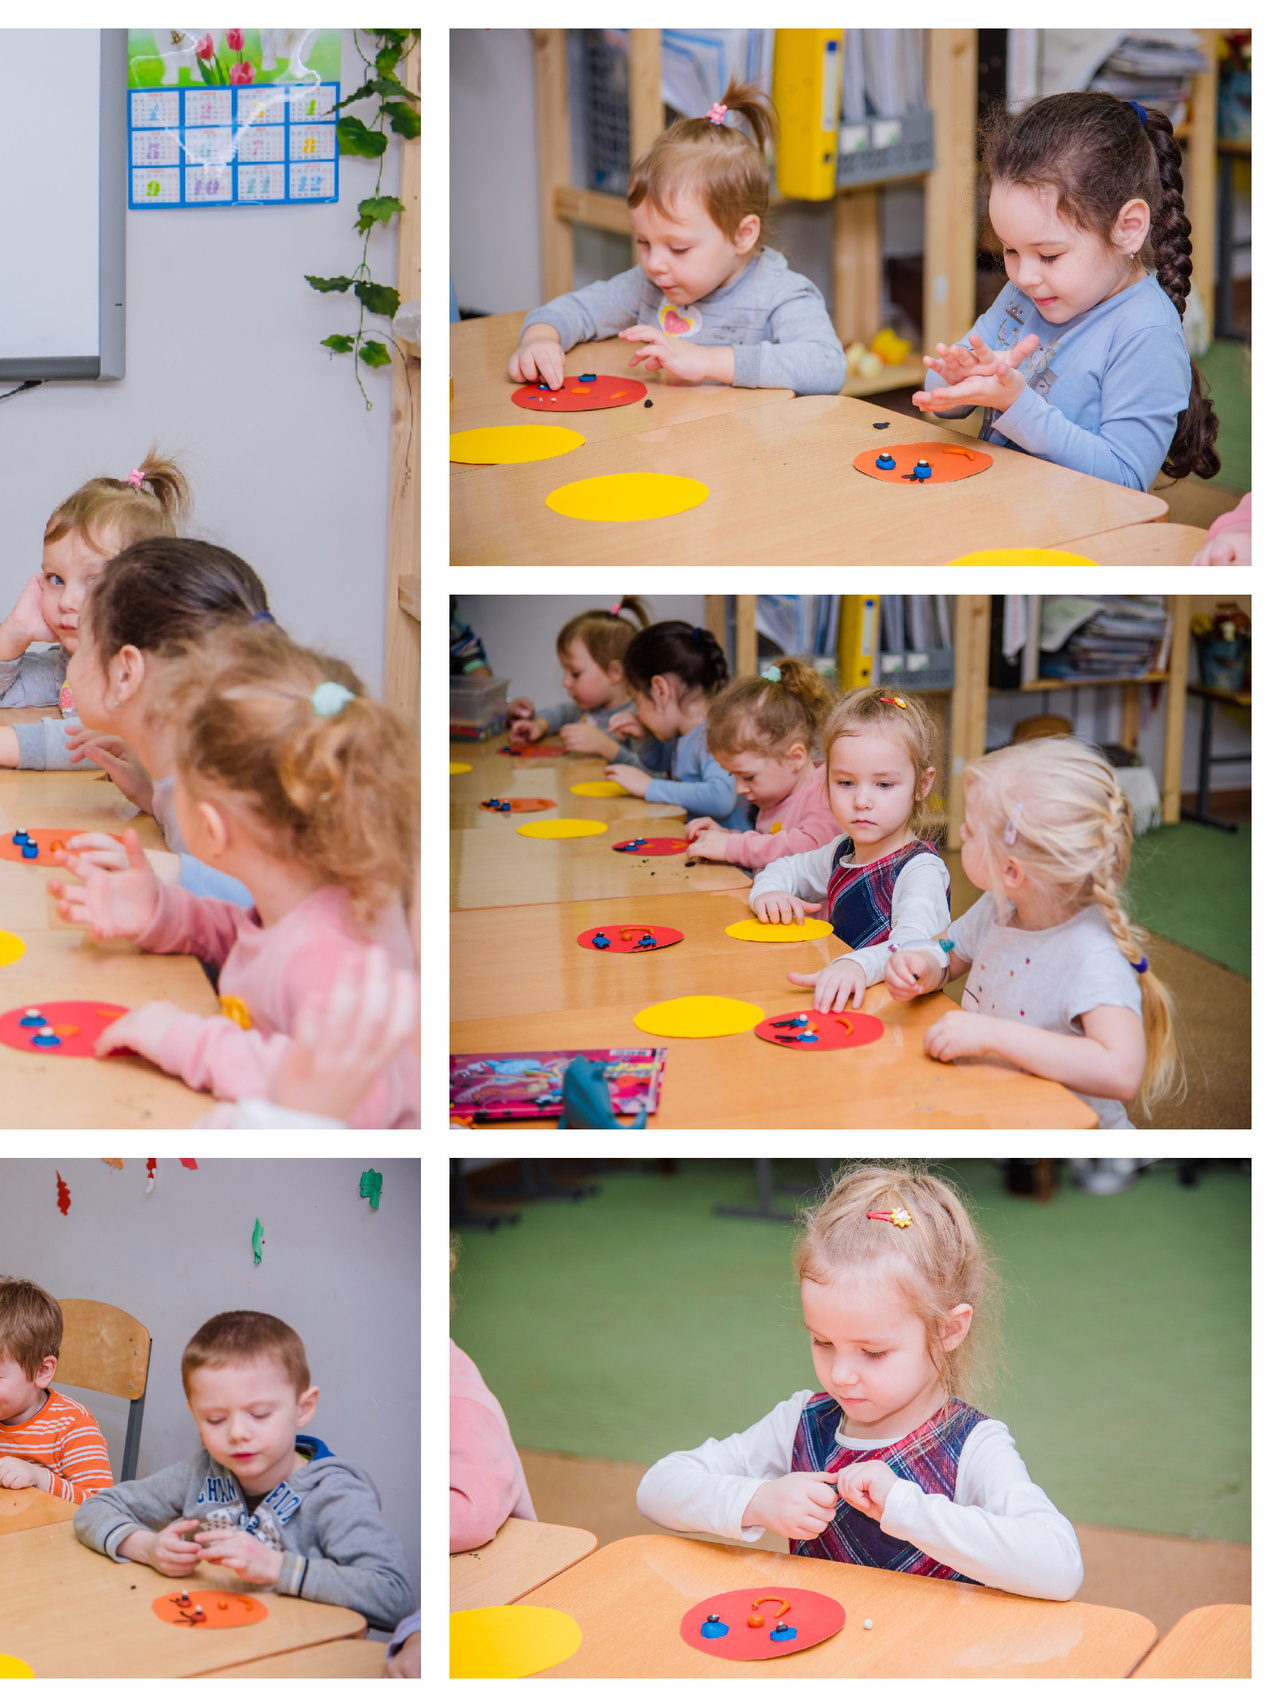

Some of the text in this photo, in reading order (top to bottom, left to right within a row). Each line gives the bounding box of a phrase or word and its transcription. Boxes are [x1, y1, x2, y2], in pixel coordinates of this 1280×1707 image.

[146, 142, 160, 160] 5
[252, 140, 264, 156] 7
[303, 136, 317, 154] 8
[146, 180, 161, 197] 9
[194, 178, 220, 196] 10
[247, 176, 271, 195] 11
[298, 175, 322, 192] 12
